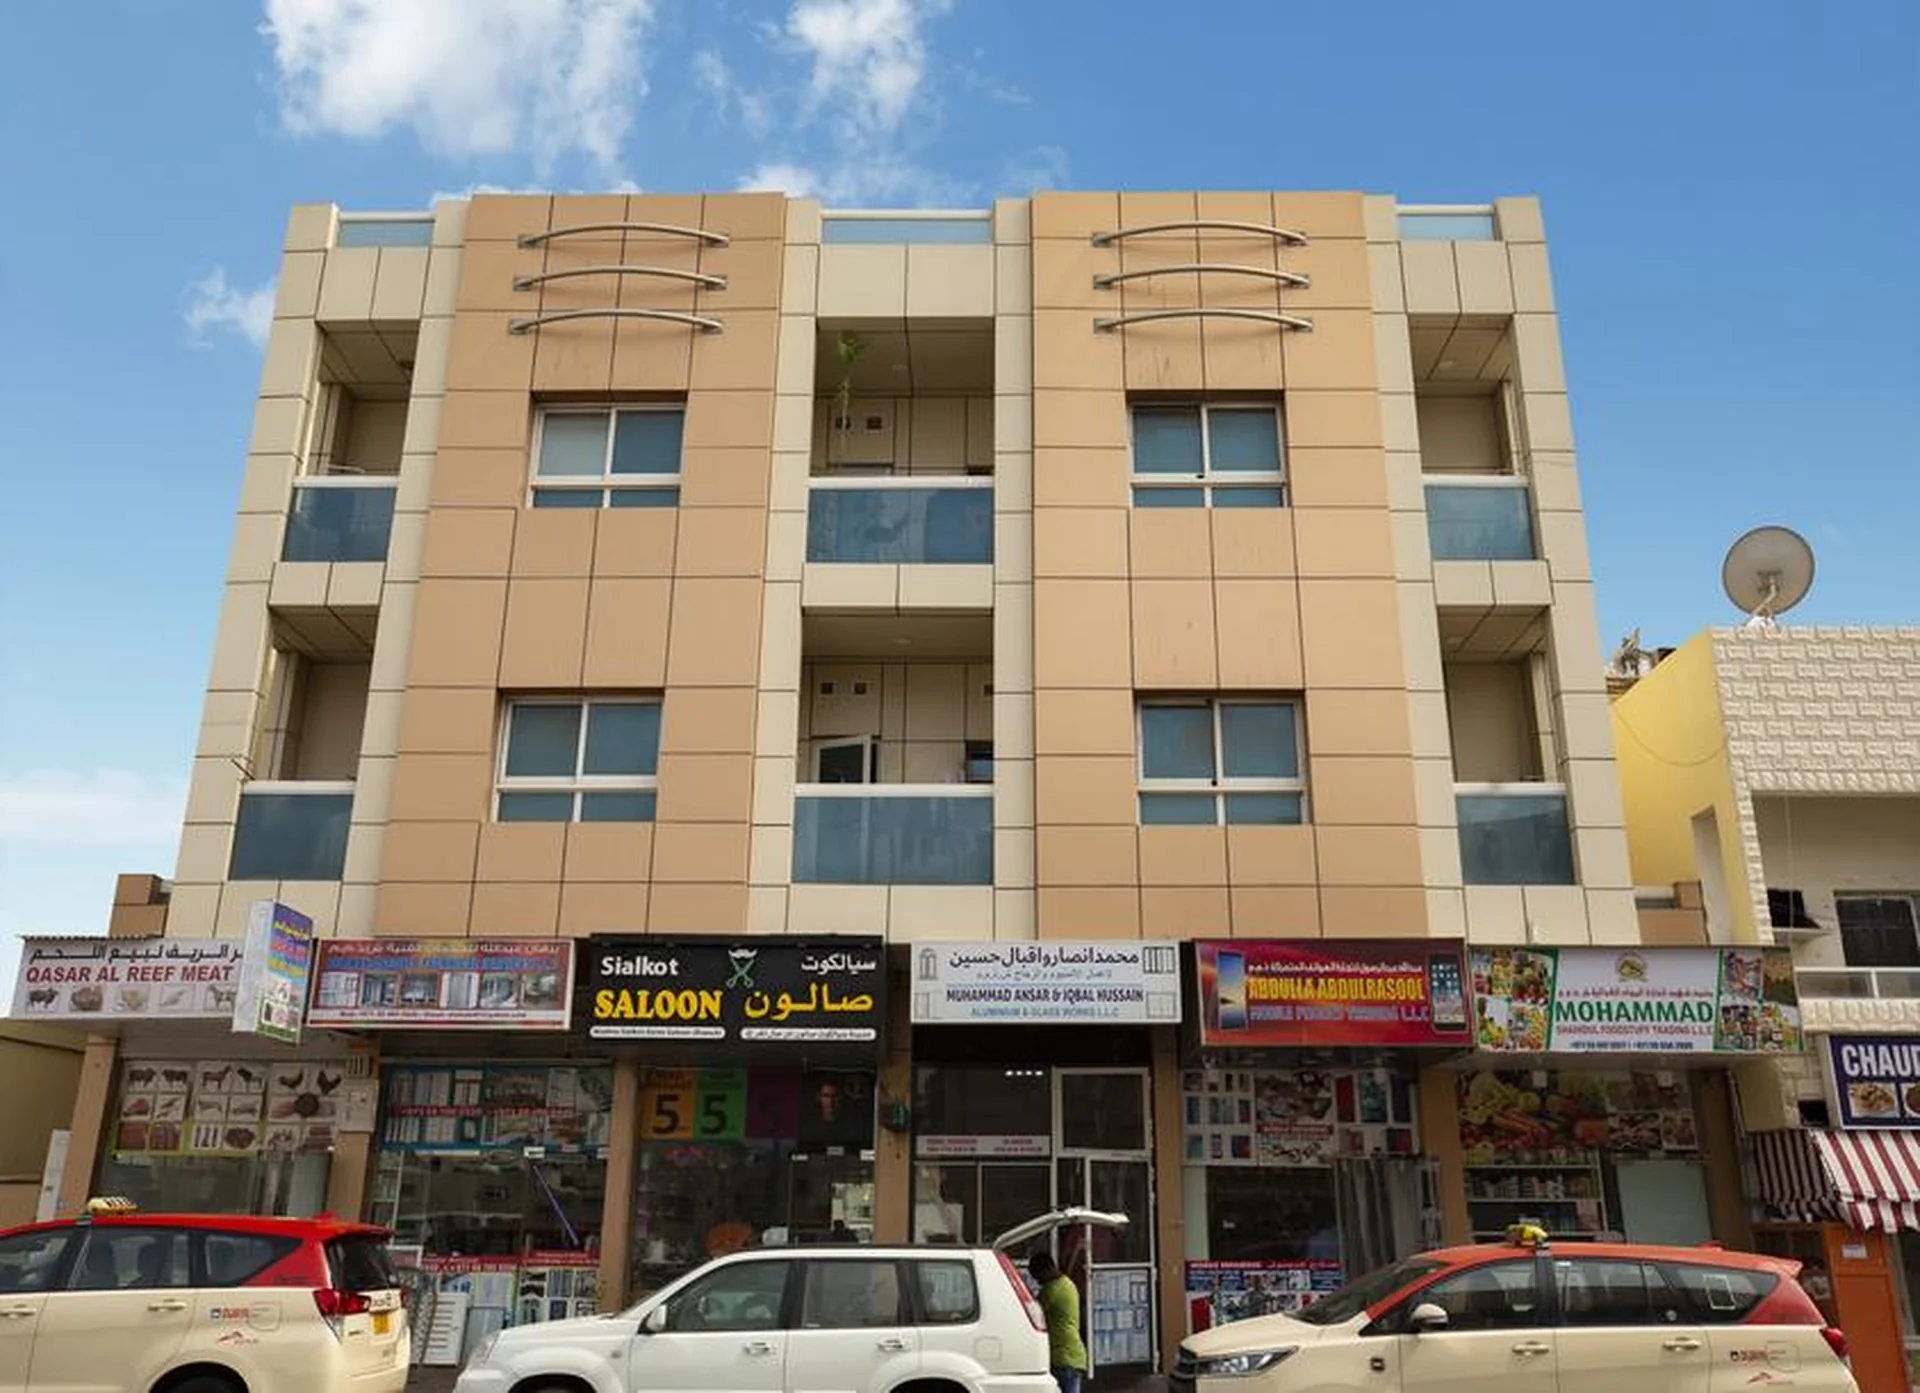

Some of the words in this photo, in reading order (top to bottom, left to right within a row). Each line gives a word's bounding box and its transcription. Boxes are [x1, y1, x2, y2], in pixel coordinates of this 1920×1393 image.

[26, 966, 91, 983] QASAR
[95, 966, 120, 982] AL
[126, 966, 175, 982] REEF
[180, 966, 234, 982] MEAT
[600, 956, 679, 976] Sialkot
[801, 954, 877, 975] سيالكوت
[946, 988, 1012, 1002] MUHAMMAD
[1013, 988, 1050, 1002] ANSAR
[1052, 988, 1060, 1002] &
[1062, 988, 1095, 1004] IQBAL
[1096, 988, 1144, 1002] HUSSAIN
[1248, 978, 1315, 1000] ABDULLA
[1317, 978, 1425, 1000] ABDULRASOOL
[594, 989, 723, 1020] SALOON
[745, 982, 874, 1021] صالون
[1555, 1001, 1713, 1022] MOHAMMAD
[653, 1094, 680, 1134] 5
[700, 1094, 728, 1135] 5
